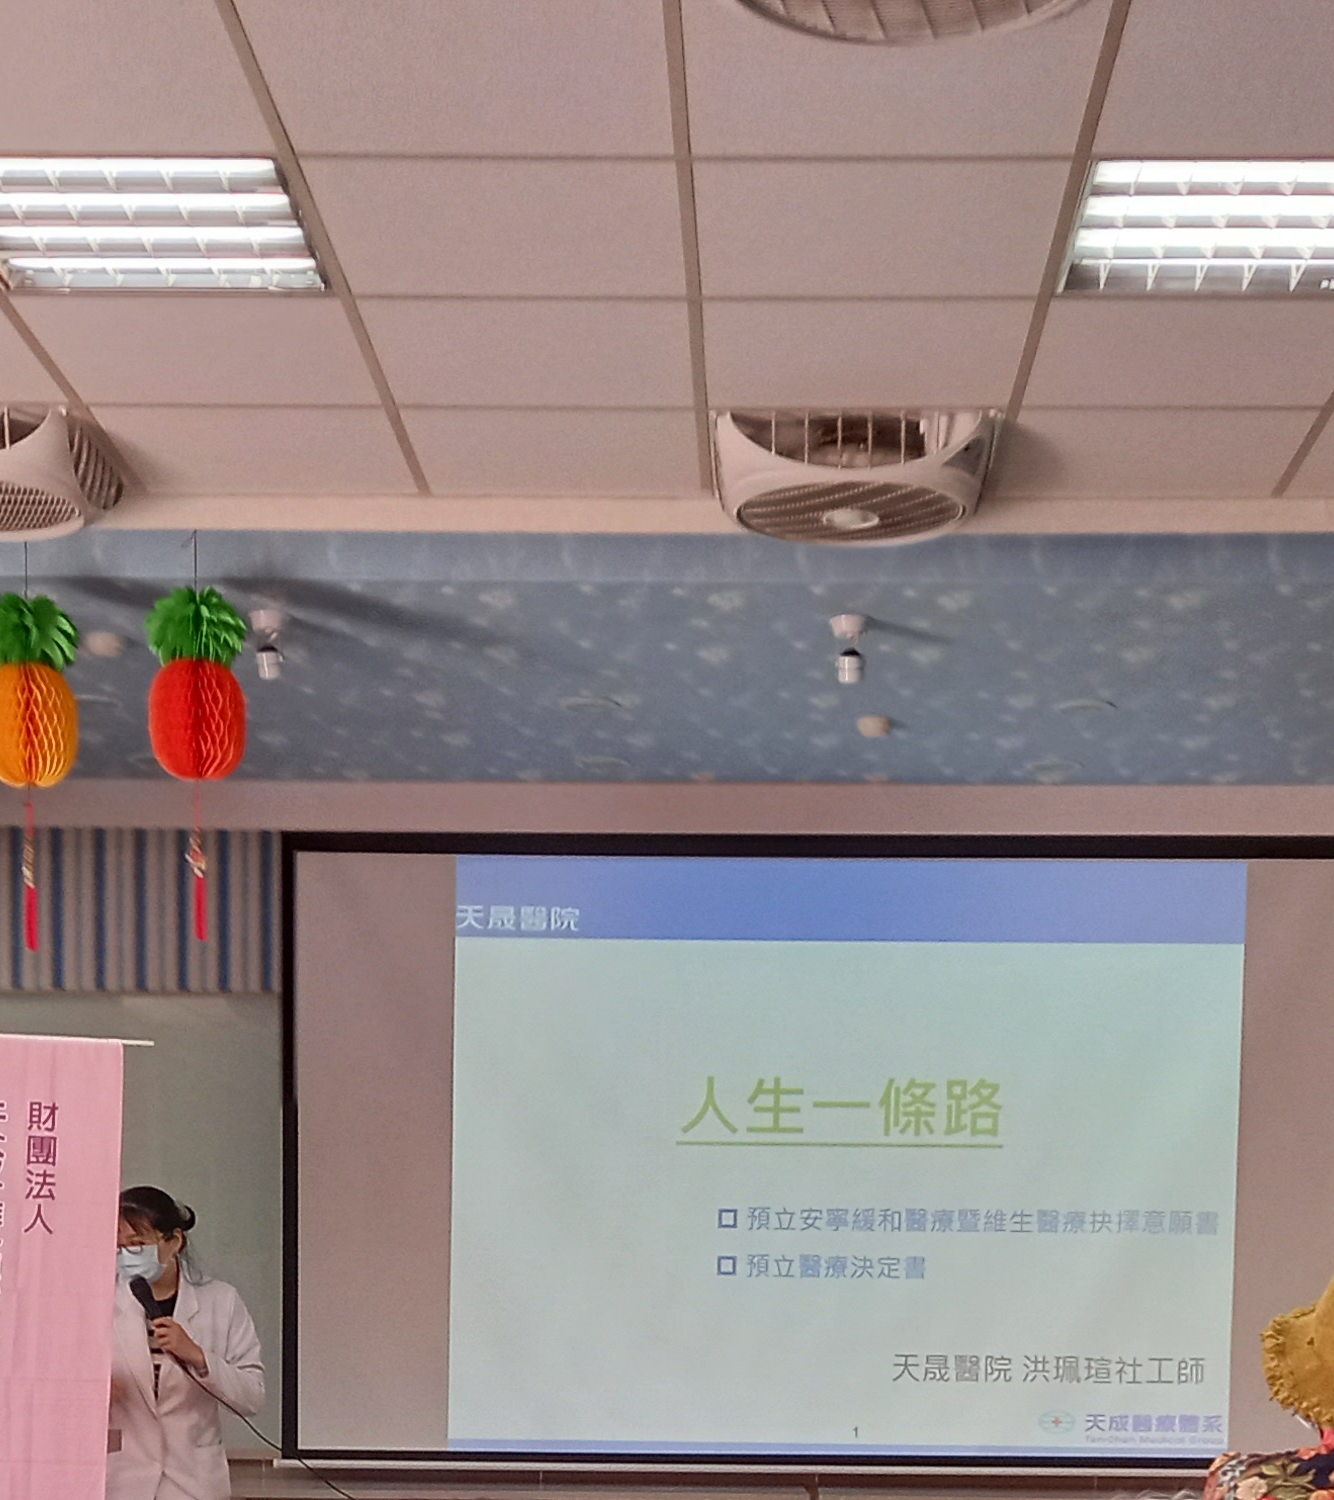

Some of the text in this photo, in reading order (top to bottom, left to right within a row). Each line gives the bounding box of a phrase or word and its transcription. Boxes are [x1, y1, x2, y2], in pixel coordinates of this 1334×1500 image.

[456, 905, 579, 931] 天晟醫院
[680, 1075, 1005, 1138] 人生一條路
[23, 1101, 59, 1235] 財團法人
[747, 1254, 926, 1280] 預立醫療決定書
[892, 1353, 1012, 1383] 天晟醫院
[853, 1426, 860, 1439] 1
